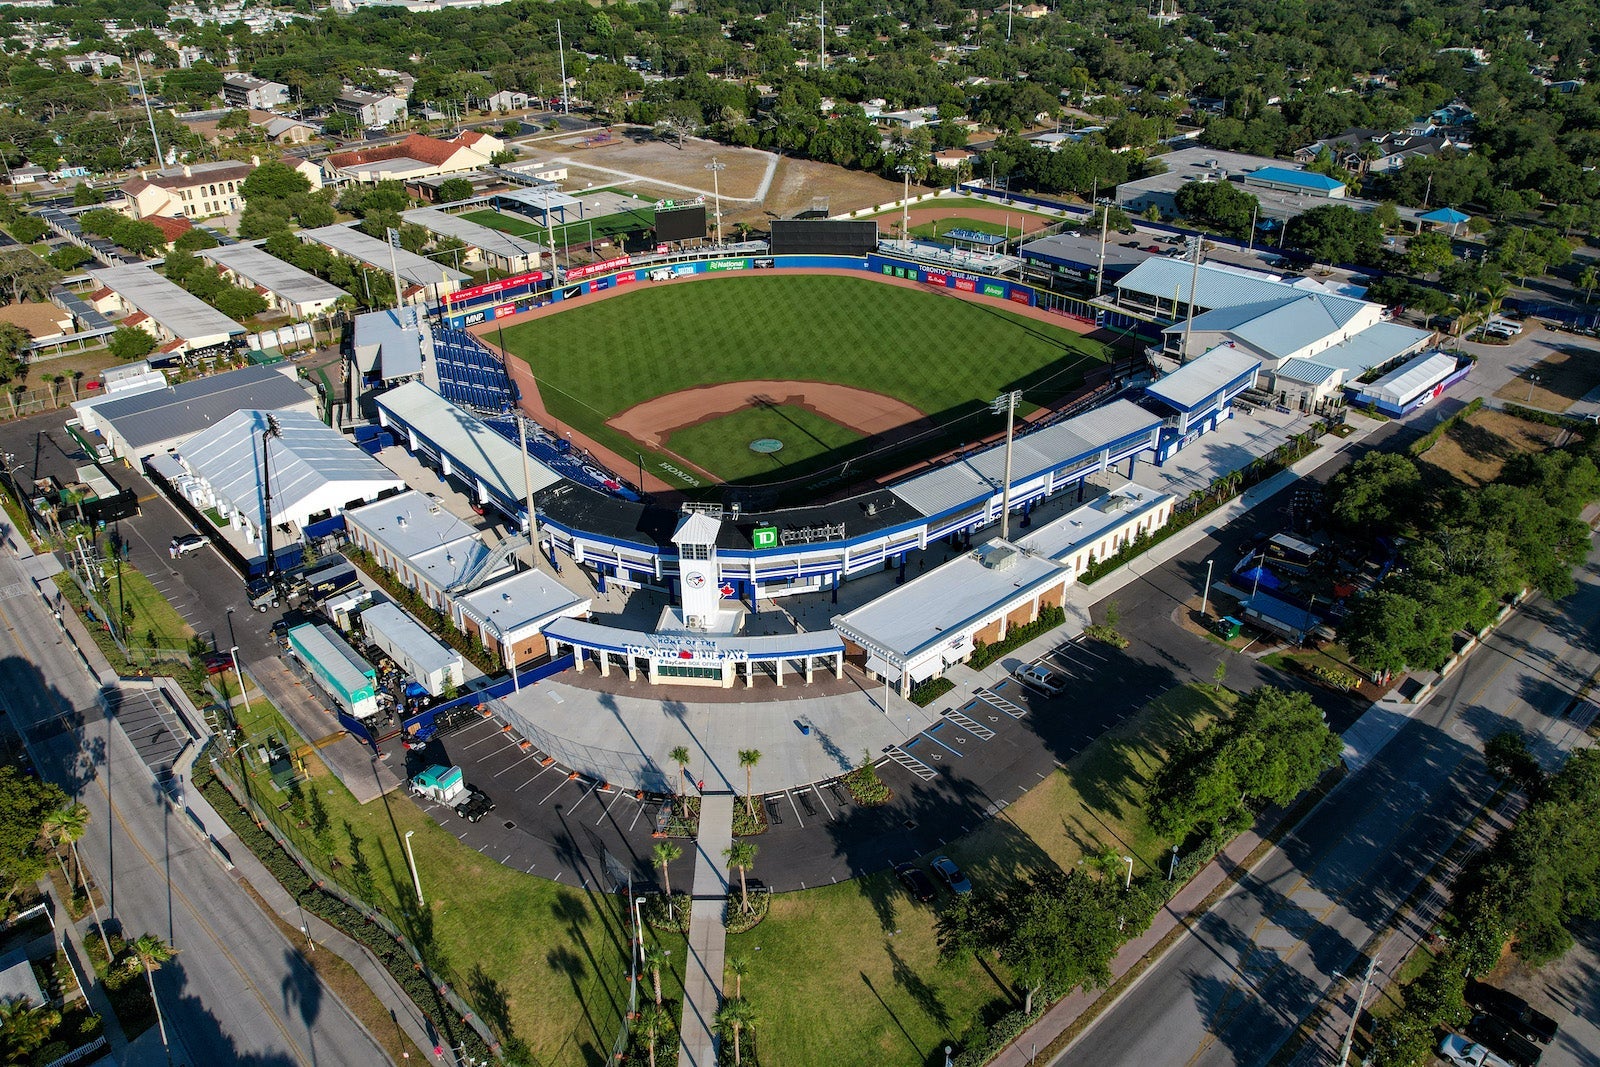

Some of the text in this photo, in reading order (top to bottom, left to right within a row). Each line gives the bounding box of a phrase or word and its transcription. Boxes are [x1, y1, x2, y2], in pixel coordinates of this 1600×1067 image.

[919, 265, 946, 276] TORONTO
[952, 270, 965, 279] BLUE
[465, 312, 484, 324] MNP
[658, 462, 700, 487] HONDA
[756, 522, 845, 544] TD Ballpark
[624, 645, 749, 660] TORONTO BLUE JAYS
